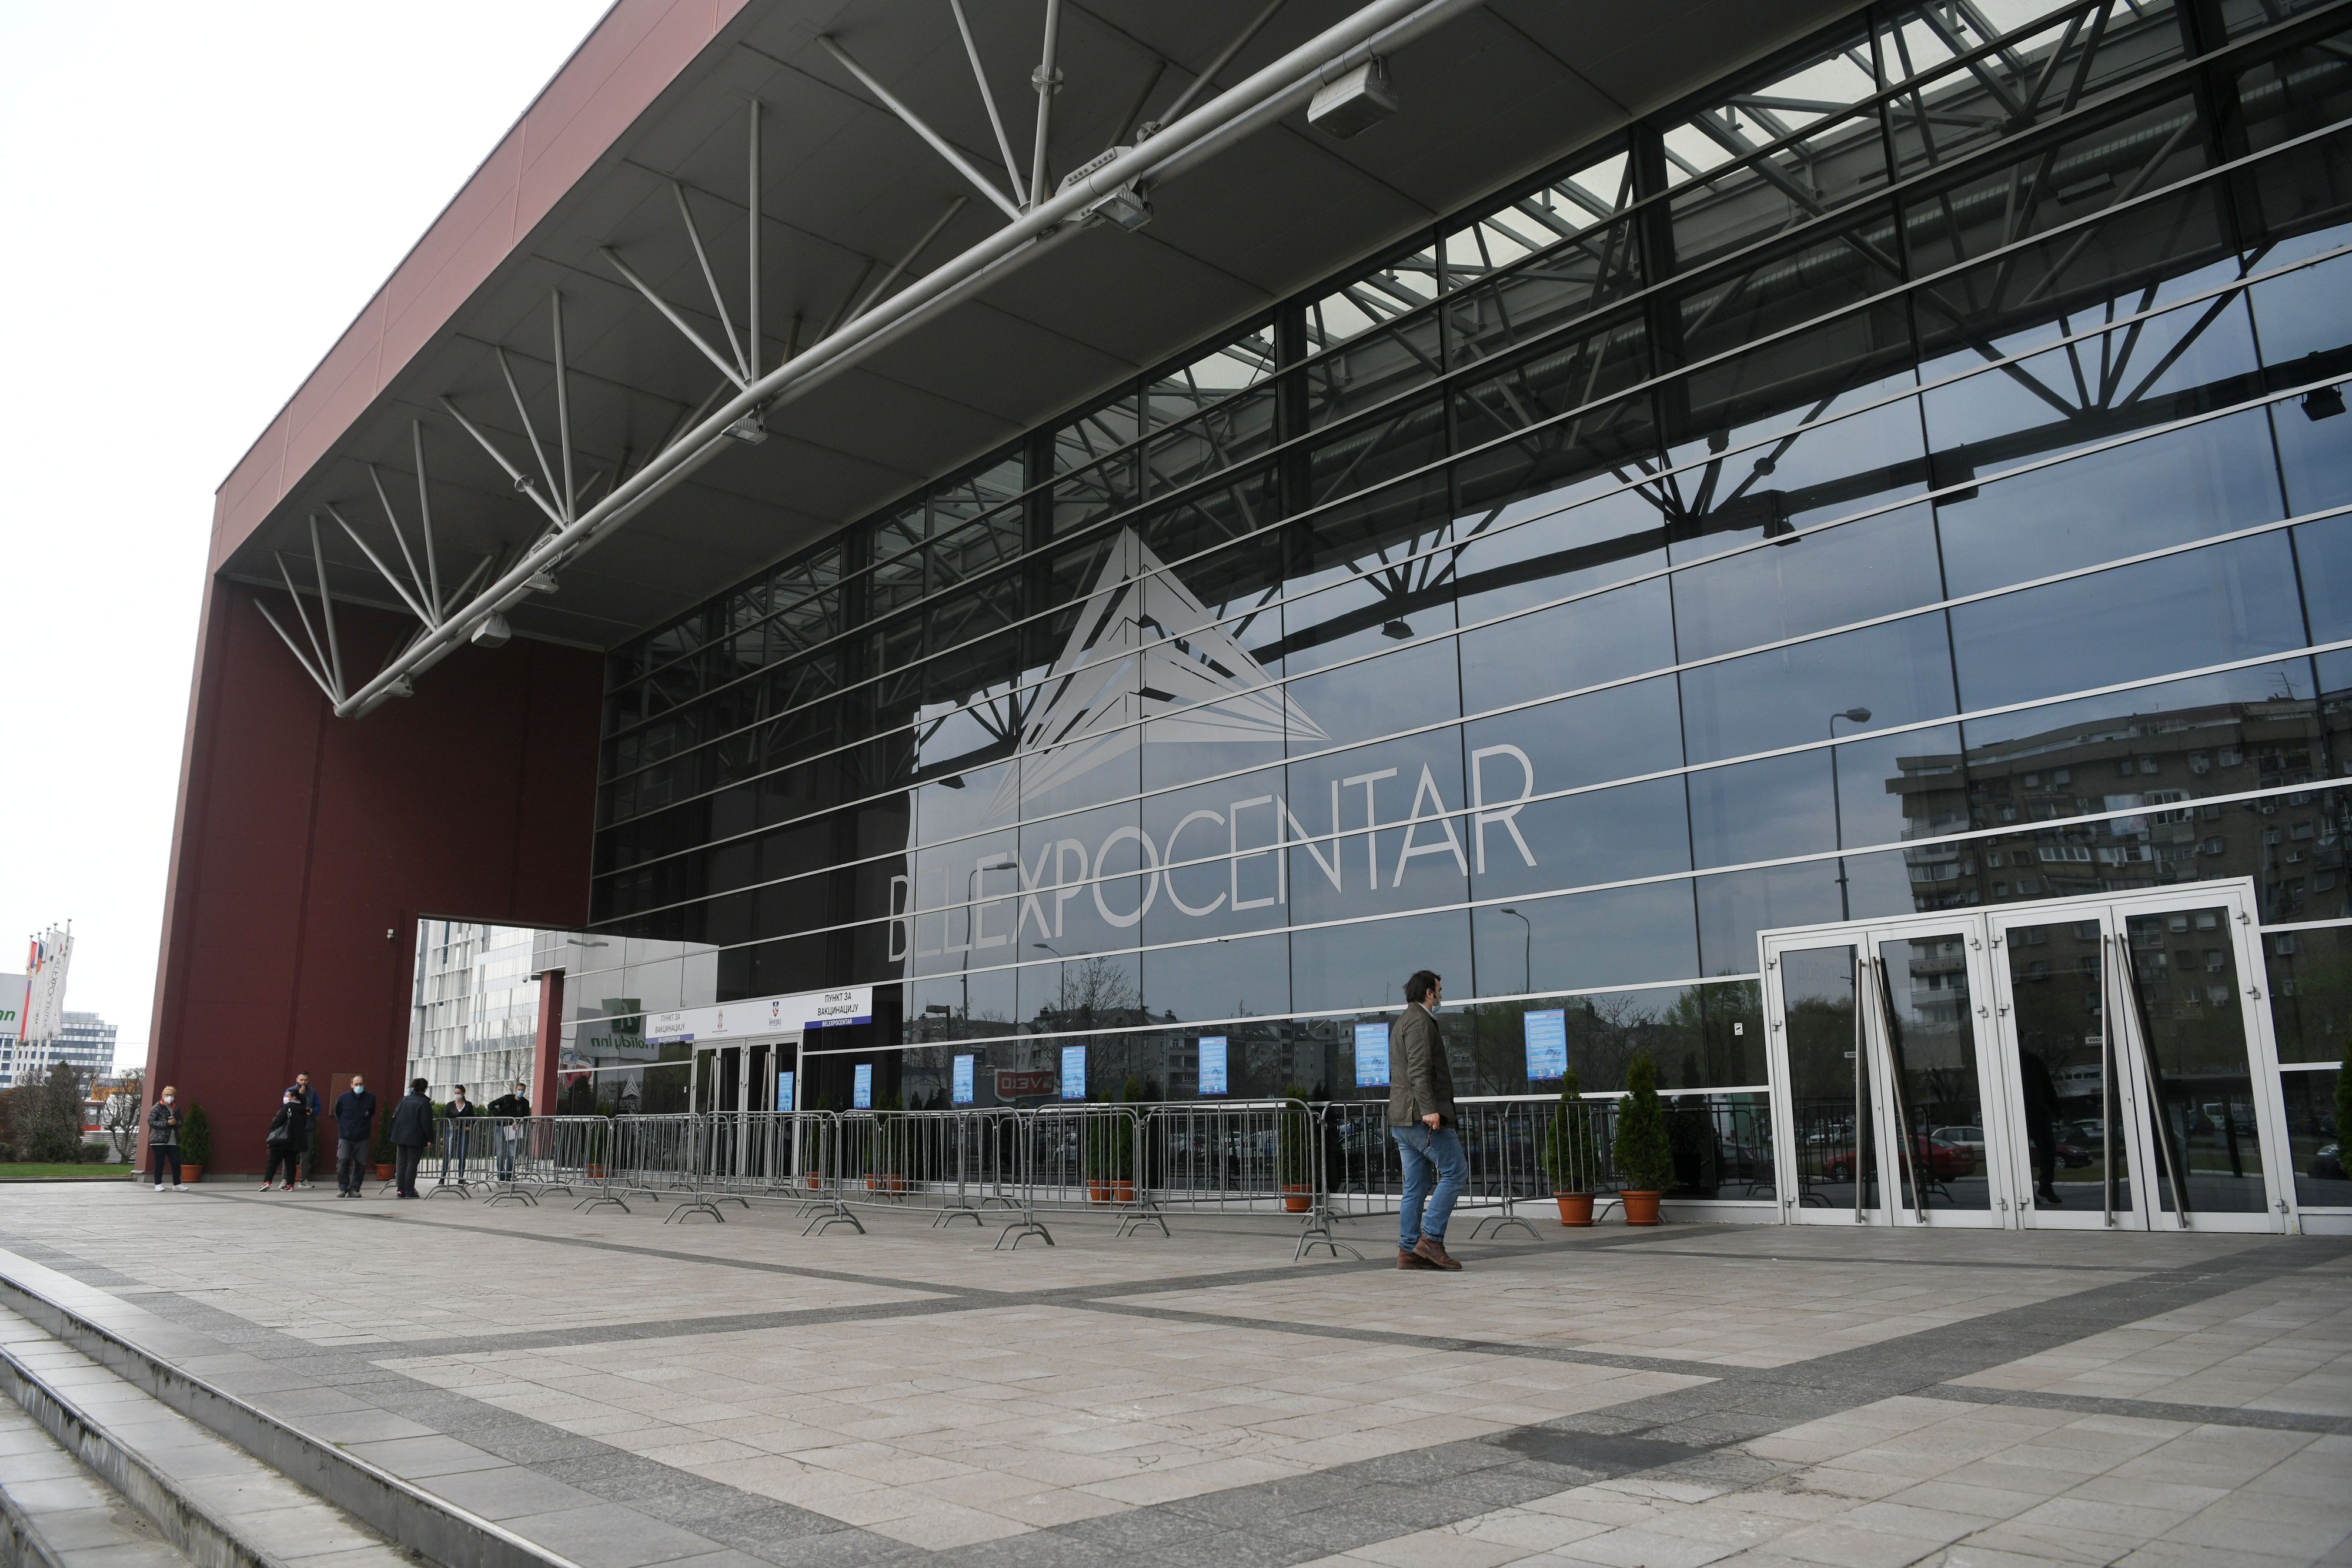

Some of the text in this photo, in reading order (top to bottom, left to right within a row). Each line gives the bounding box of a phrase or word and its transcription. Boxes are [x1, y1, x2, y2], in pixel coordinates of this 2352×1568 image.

[888, 744, 1538, 962] BELEXPOCENTAR
[824, 992, 852, 1003] ПУНКТ ЗА
[817, 1004, 858, 1017] ВАКЦИНАЦИЈУ
[660, 1014, 674, 1022] ПУНКТ
[822, 1018, 853, 1027] BELEXPOCENTAR
[655, 1023, 686, 1034] ВАКЦИНАЦИЈУ
